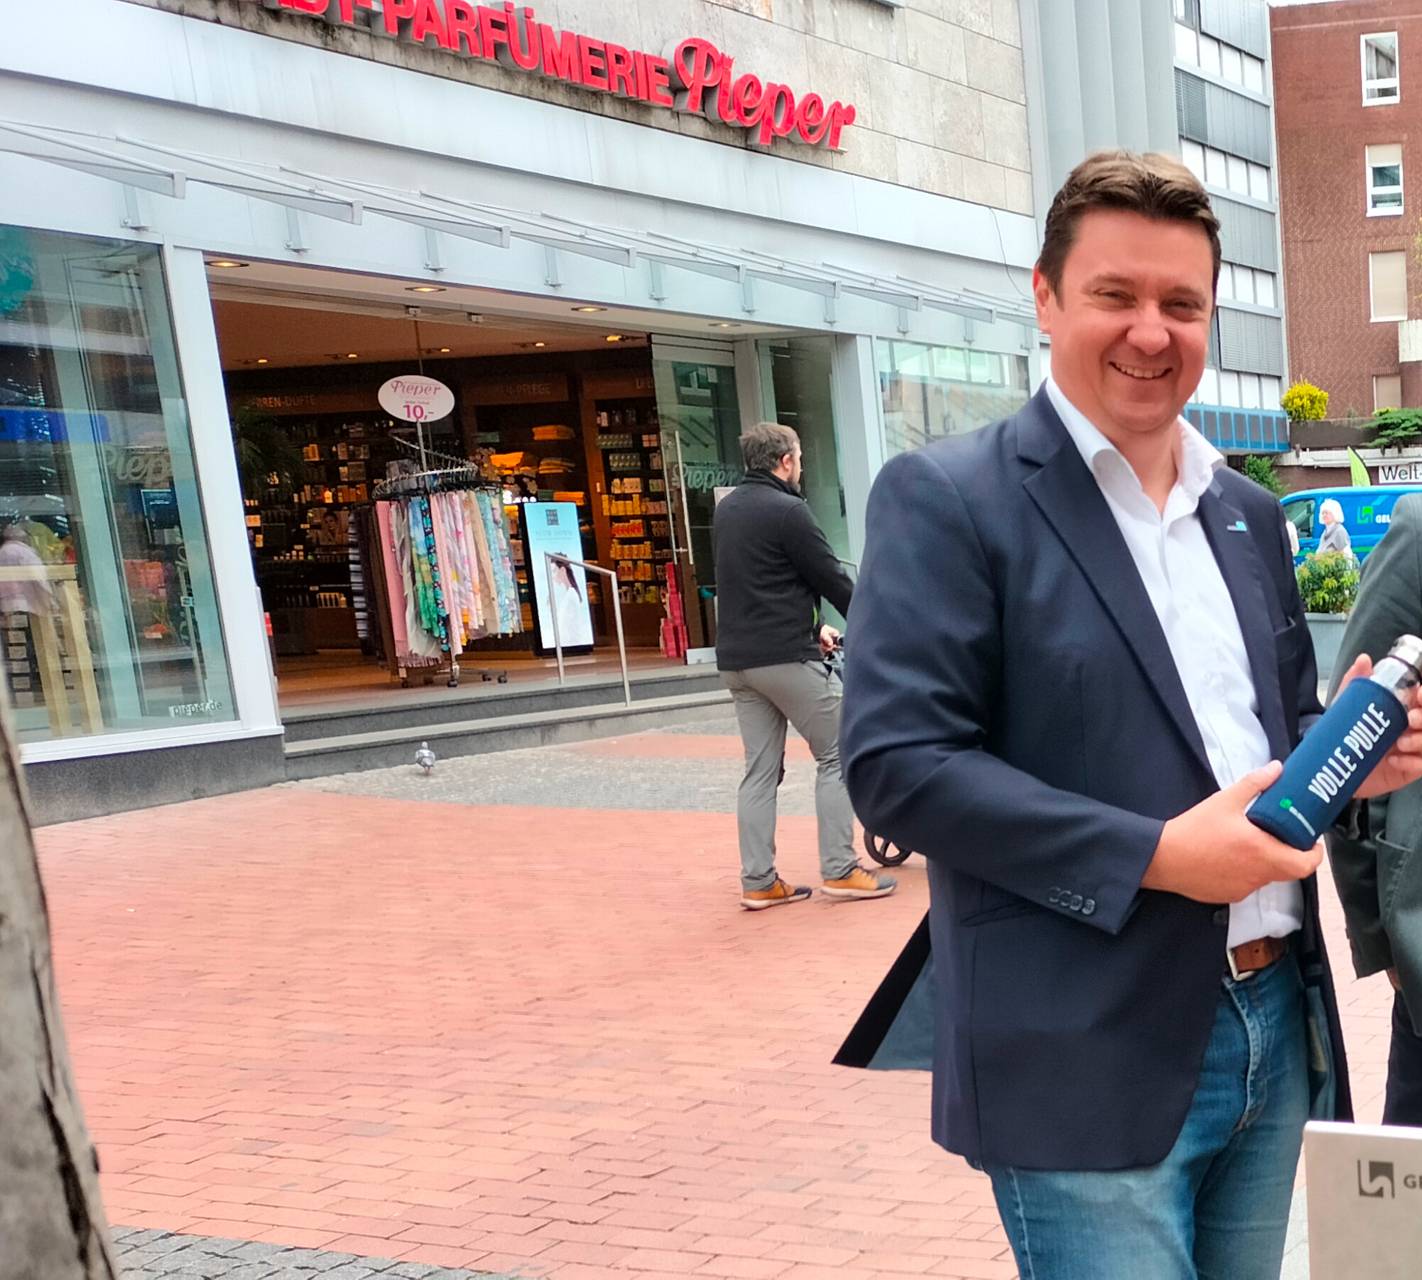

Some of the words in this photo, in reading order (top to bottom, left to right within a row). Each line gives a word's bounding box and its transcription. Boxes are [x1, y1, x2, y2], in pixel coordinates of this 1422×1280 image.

[673, 37, 857, 150] Pieper
[390, 380, 441, 396] Pieper
[1375, 514, 1392, 524] GEL
[1308, 746, 1357, 804] VOLLE
[1343, 702, 1391, 760] PULLE
